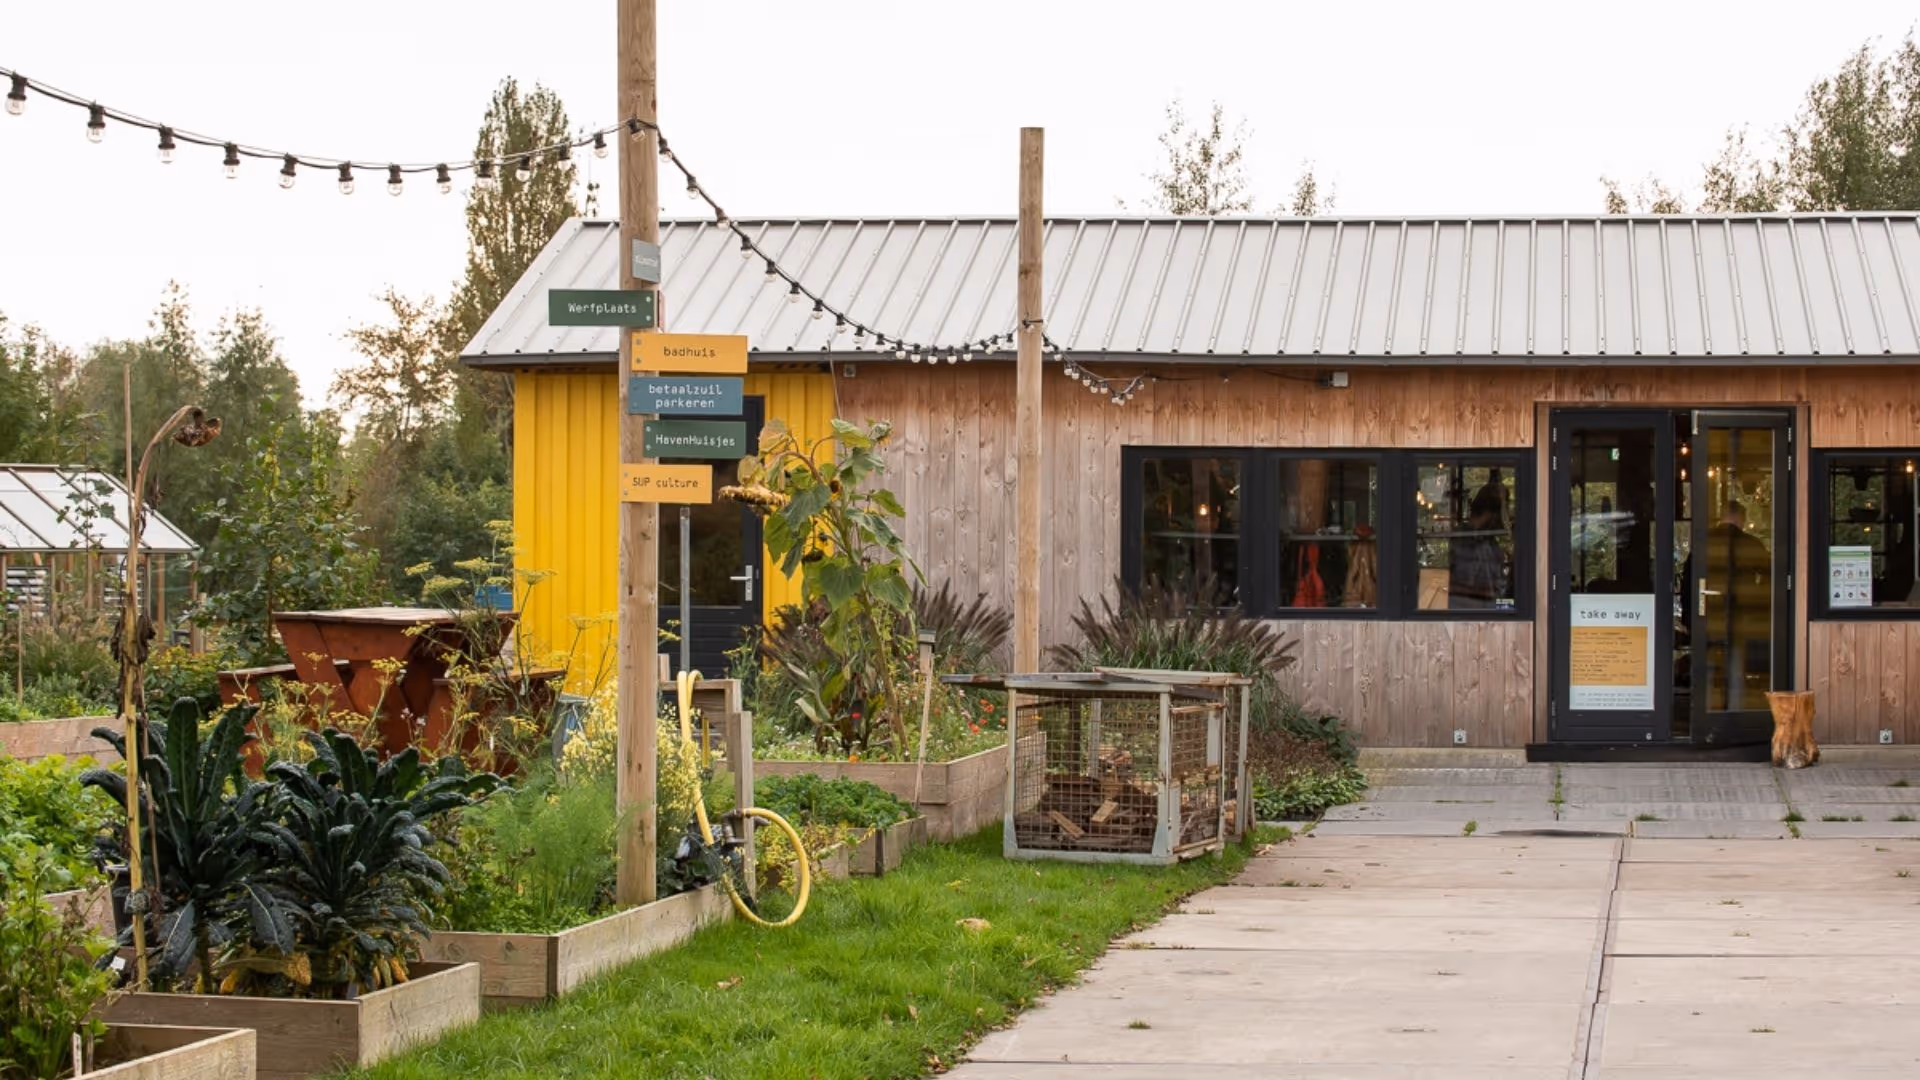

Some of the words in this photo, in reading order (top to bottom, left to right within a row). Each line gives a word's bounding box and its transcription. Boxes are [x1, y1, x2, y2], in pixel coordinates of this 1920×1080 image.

[568, 303, 637, 314] Werfplaats
[663, 346, 716, 358] badhuis
[649, 384, 722, 395] betaalzuil
[655, 397, 715, 409] parkeren
[655, 434, 736, 448] HavenHuisjes
[632, 477, 651, 487] SUP
[656, 477, 698, 488] culture
[1580, 609, 1608, 619] take
[1614, 611, 1641, 620] away
